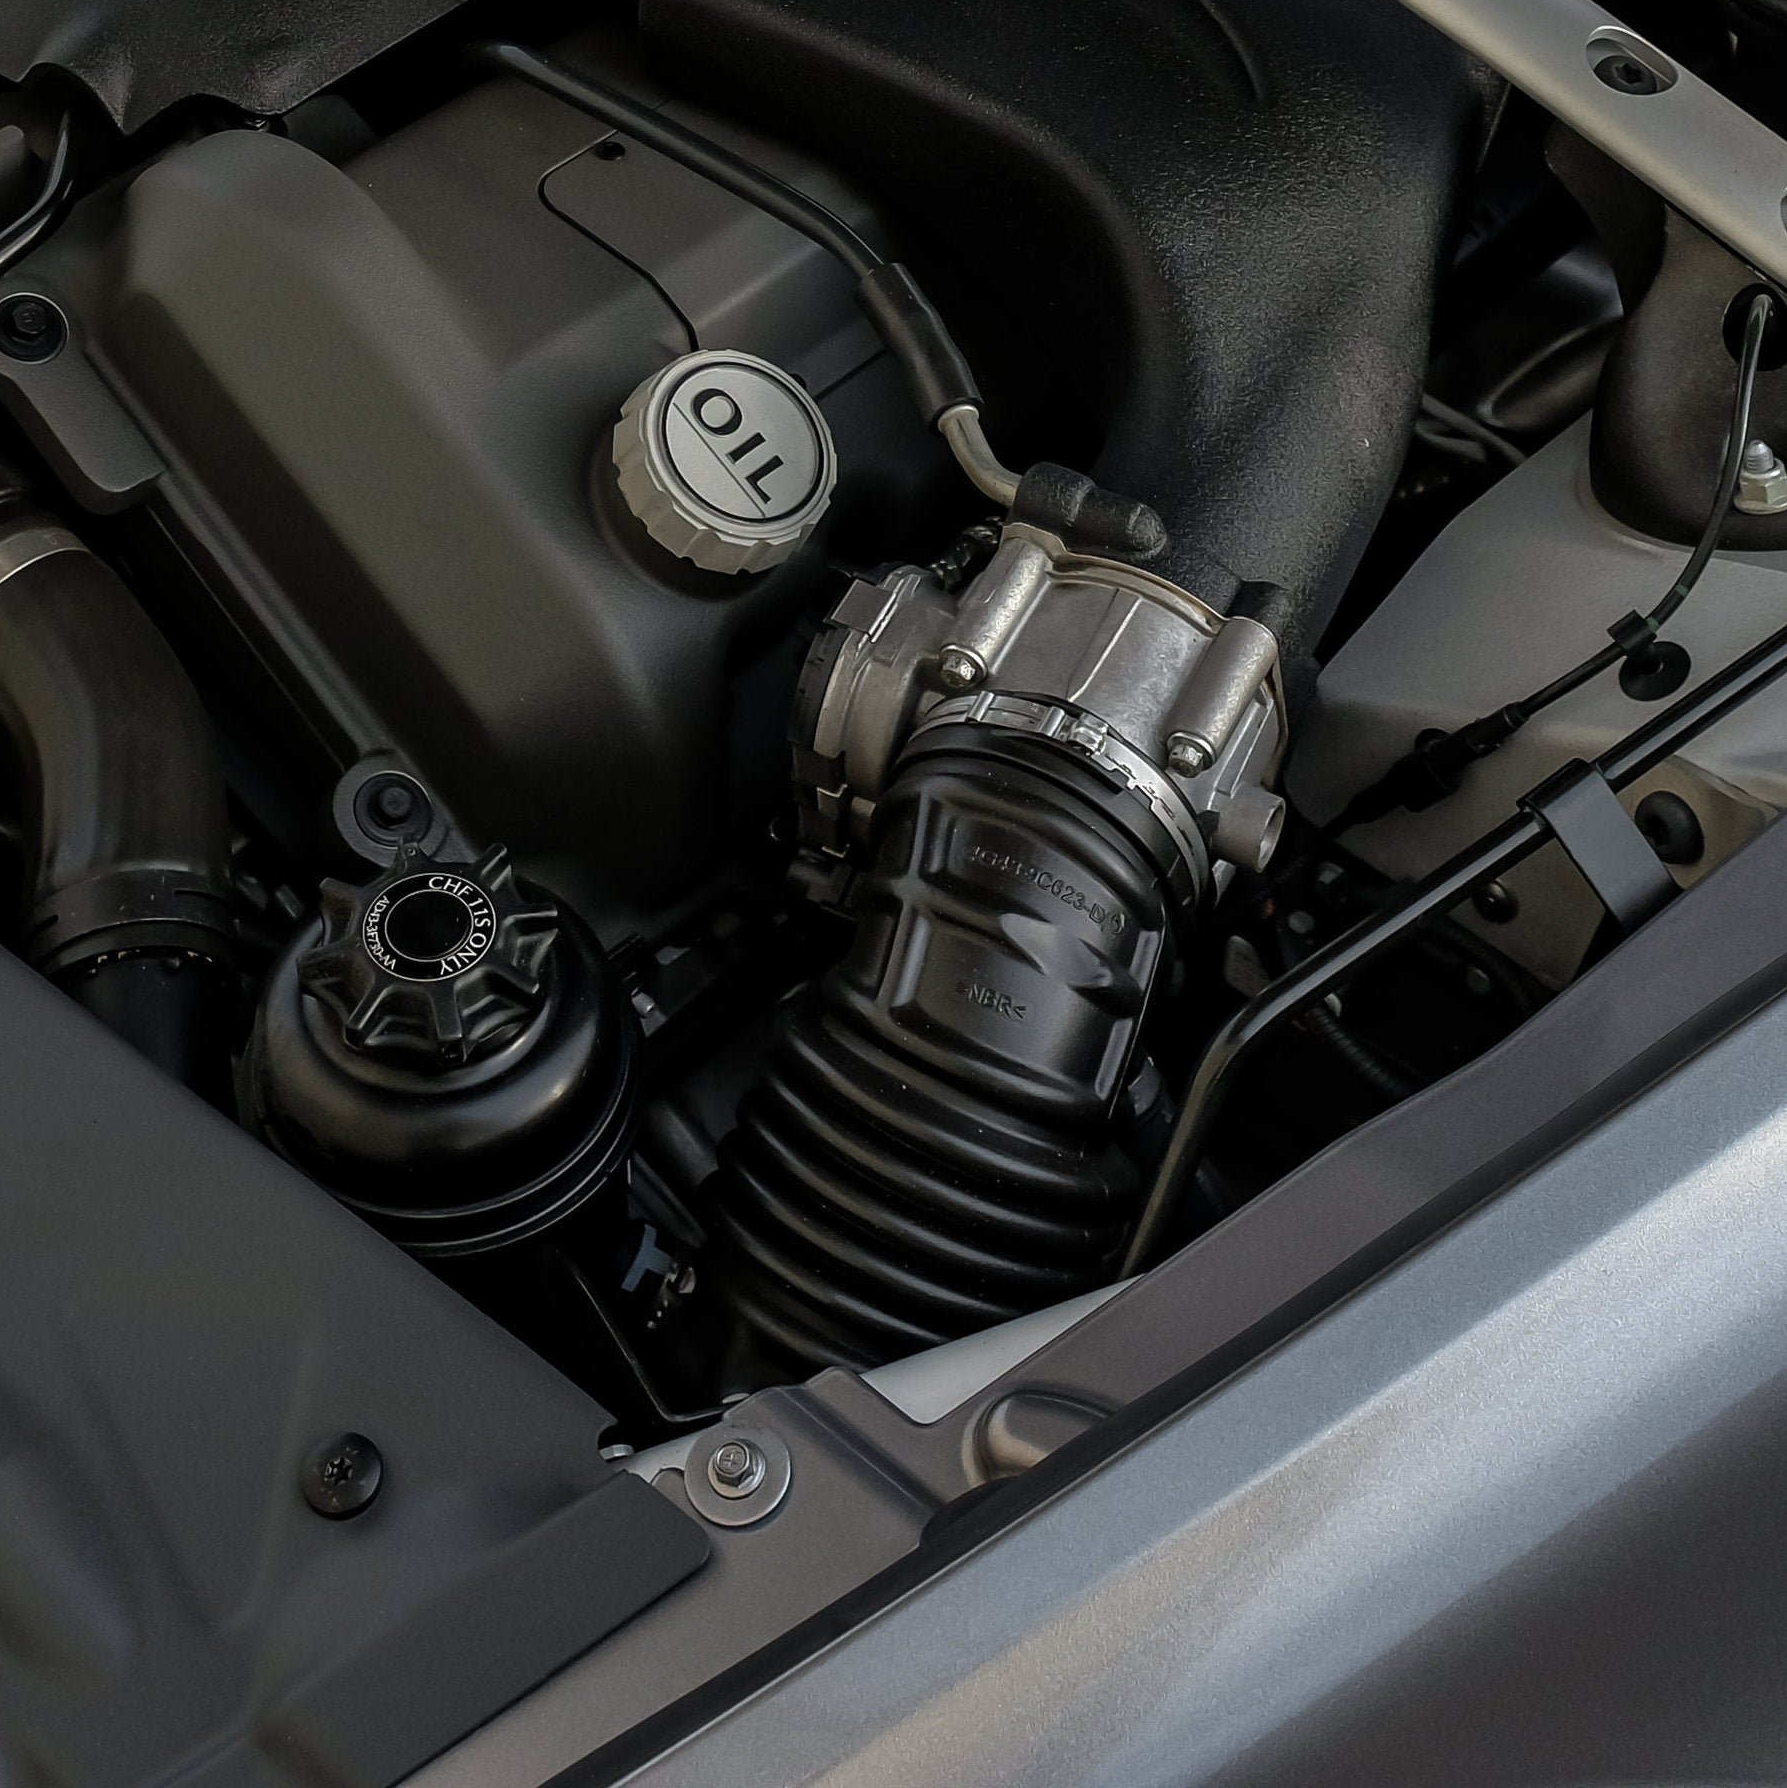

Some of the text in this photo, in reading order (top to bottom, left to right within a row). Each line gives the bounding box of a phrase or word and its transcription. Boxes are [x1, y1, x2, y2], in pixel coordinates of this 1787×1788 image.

[692, 387, 786, 506] OIL
[428, 876, 491, 976] CHF 11S ONLY
